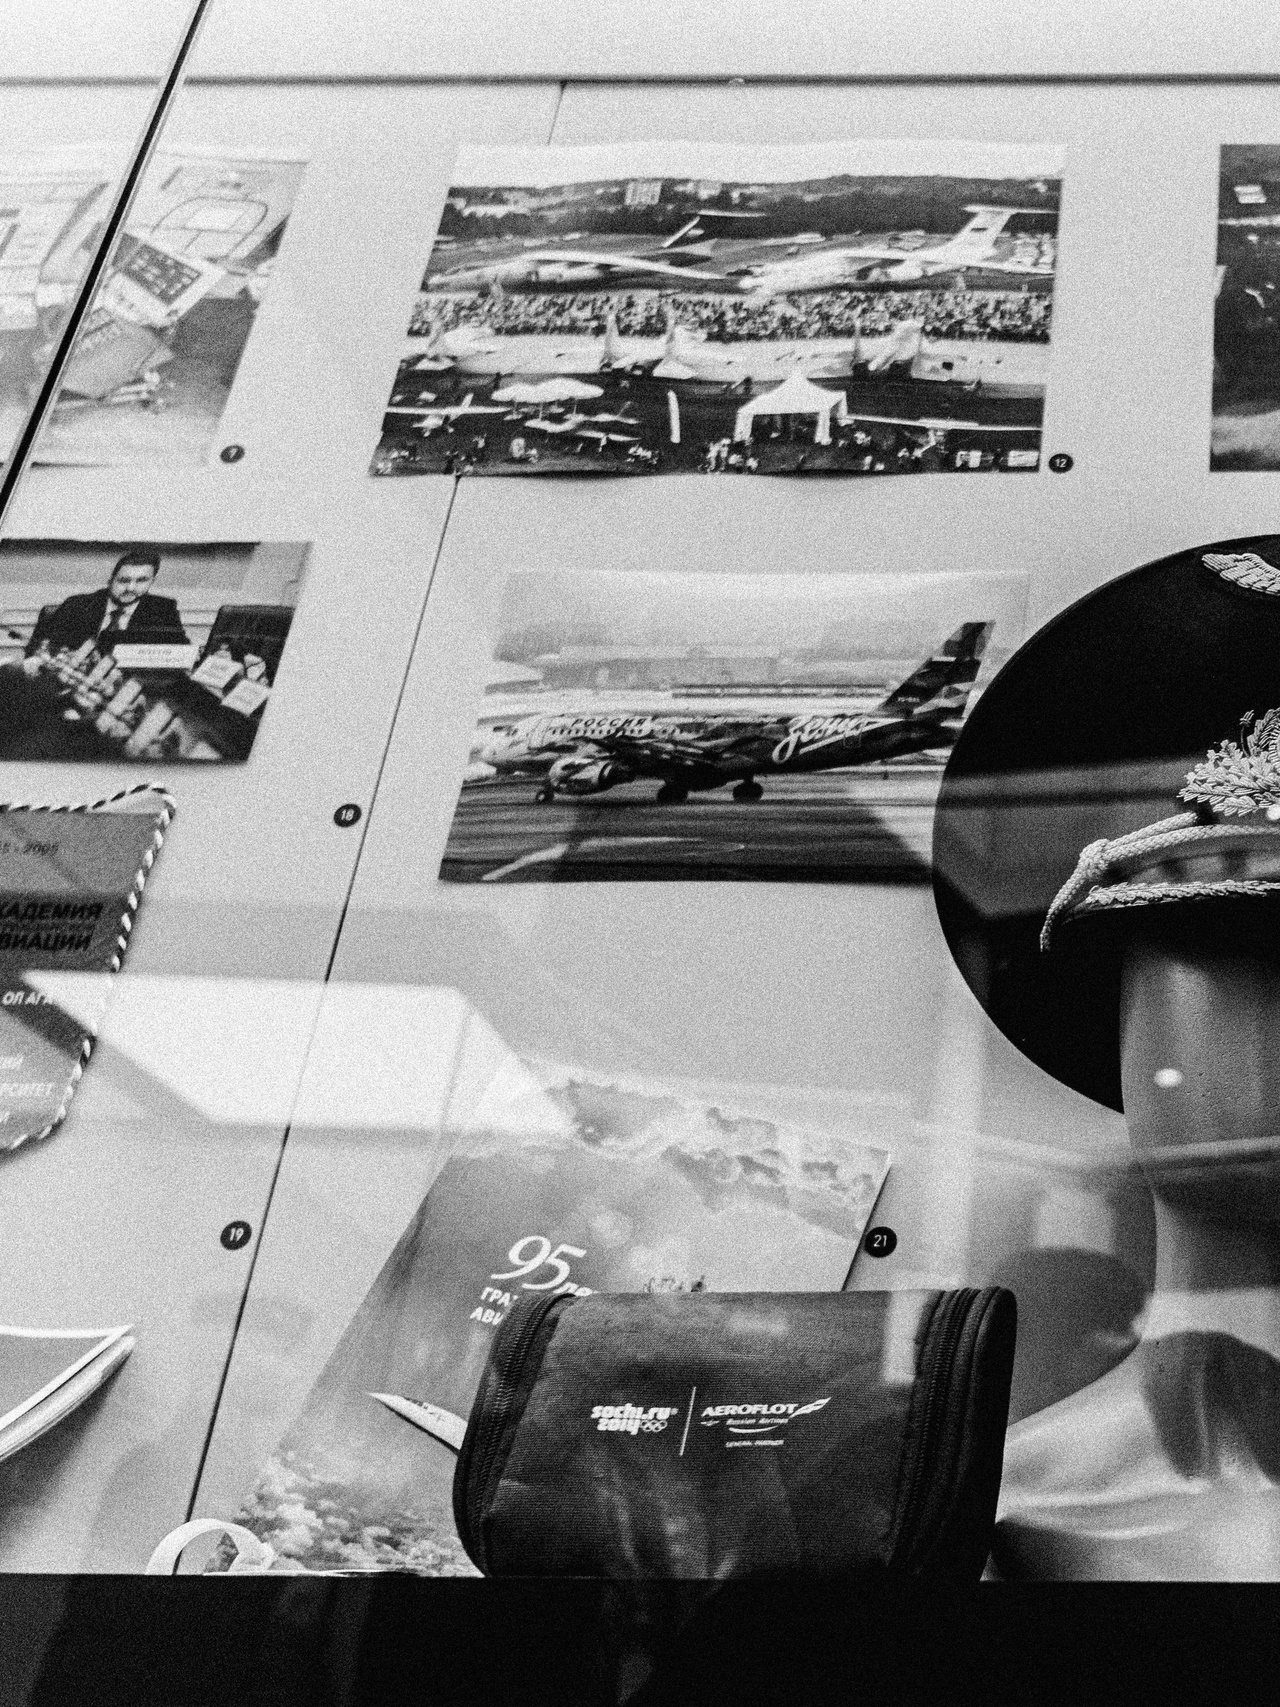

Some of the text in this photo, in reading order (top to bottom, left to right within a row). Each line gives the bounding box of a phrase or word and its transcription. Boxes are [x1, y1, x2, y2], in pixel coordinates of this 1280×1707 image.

[1053, 457, 1068, 469] 12
[571, 717, 646, 729] РОССИЯ
[339, 808, 355, 821] 18
[228, 1228, 246, 1242] 19
[872, 1234, 888, 1248] 21
[490, 1235, 587, 1290] 95
[701, 1403, 799, 1418] AEROFLOT
[597, 1418, 640, 1436] 2014
